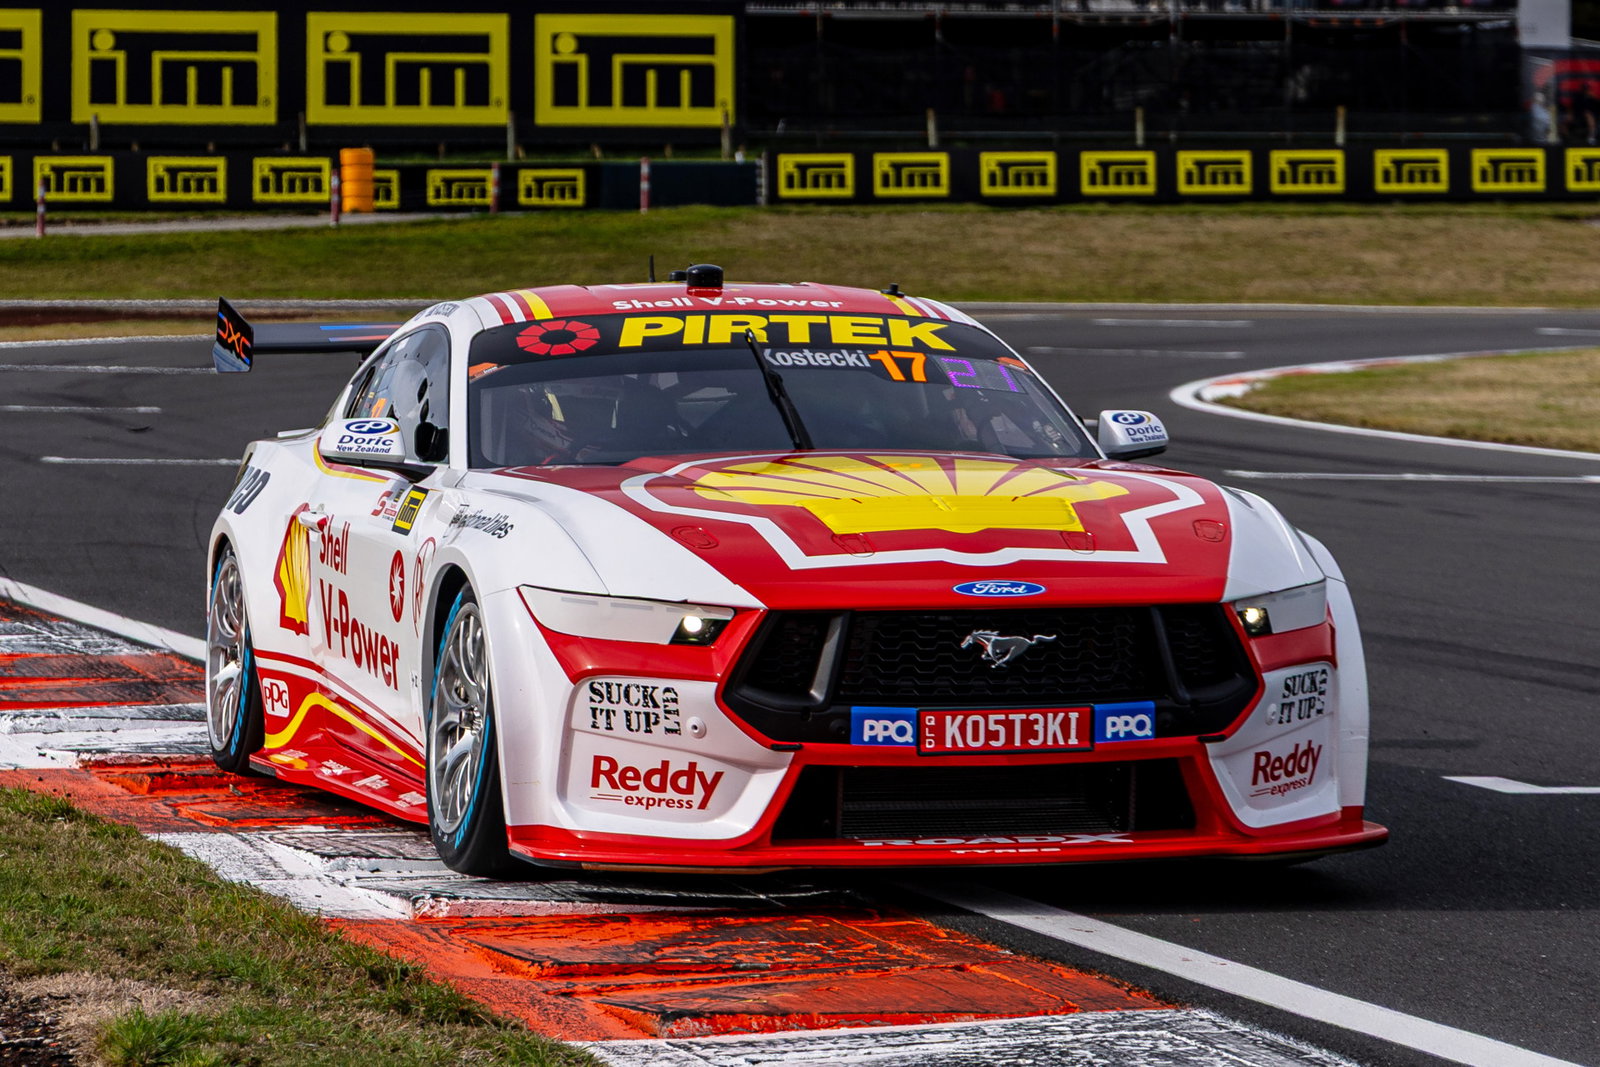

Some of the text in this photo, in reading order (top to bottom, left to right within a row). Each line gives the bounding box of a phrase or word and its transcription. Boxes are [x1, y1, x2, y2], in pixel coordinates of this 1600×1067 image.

[612, 297, 843, 310] Shell V-Power
[619, 314, 957, 351] PIRTEK
[868, 350, 927, 382] 17
[338, 434, 394, 446] Doric
[1125, 425, 1162, 436] Doric
[319, 514, 351, 576] Shell
[971, 582, 1027, 595] Ford
[319, 577, 400, 691] V-Power
[264, 682, 288, 712] PPG
[589, 681, 661, 709] SUCK
[1282, 670, 1320, 699] SUCK
[589, 706, 661, 734] IT UP
[1278, 696, 1316, 725] IT UP
[863, 719, 914, 743] PPQ
[1105, 714, 1152, 739] PPQ
[1251, 739, 1323, 786] Reddy
[591, 754, 725, 810] Reddy
[1270, 777, 1307, 797] express
[624, 794, 694, 810] express
